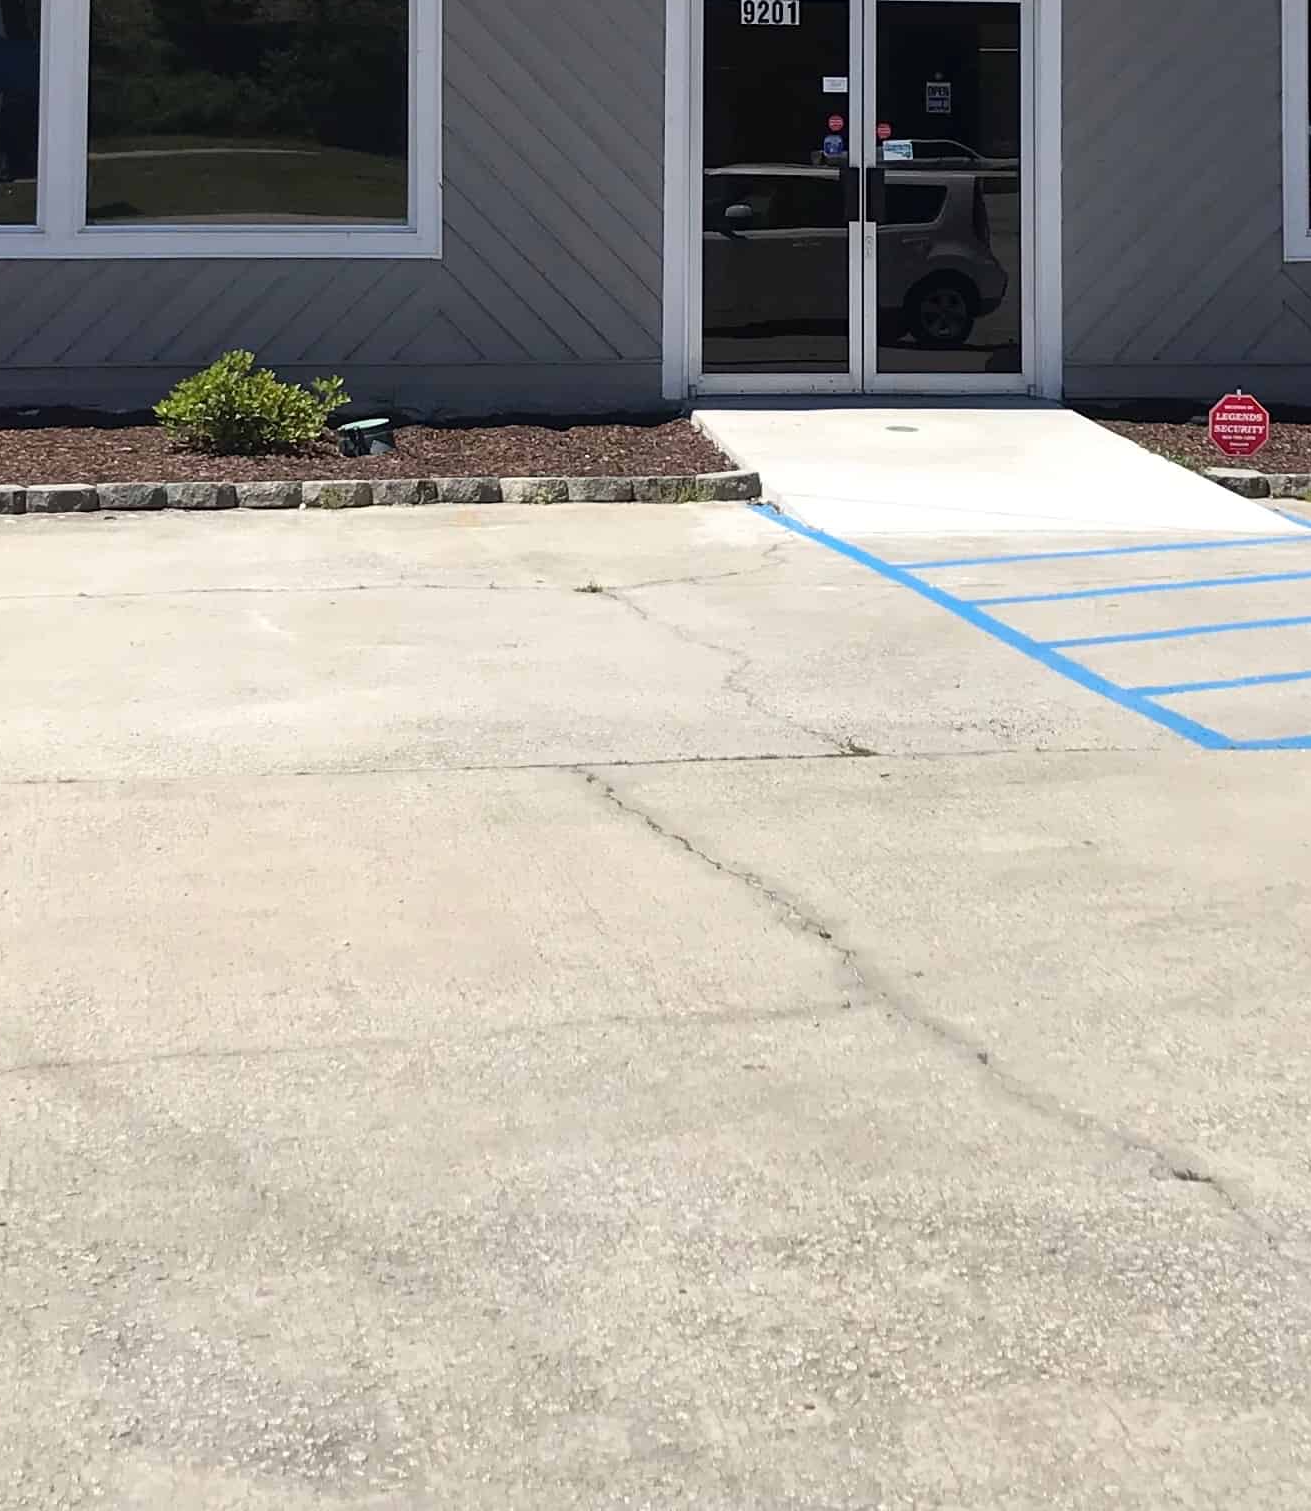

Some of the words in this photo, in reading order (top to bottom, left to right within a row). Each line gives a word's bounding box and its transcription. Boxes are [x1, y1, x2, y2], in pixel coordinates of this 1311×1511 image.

[743, 0, 797, 24] 9201
[1215, 412, 1264, 422] LEGENDS
[1213, 424, 1266, 434] SECURITY
